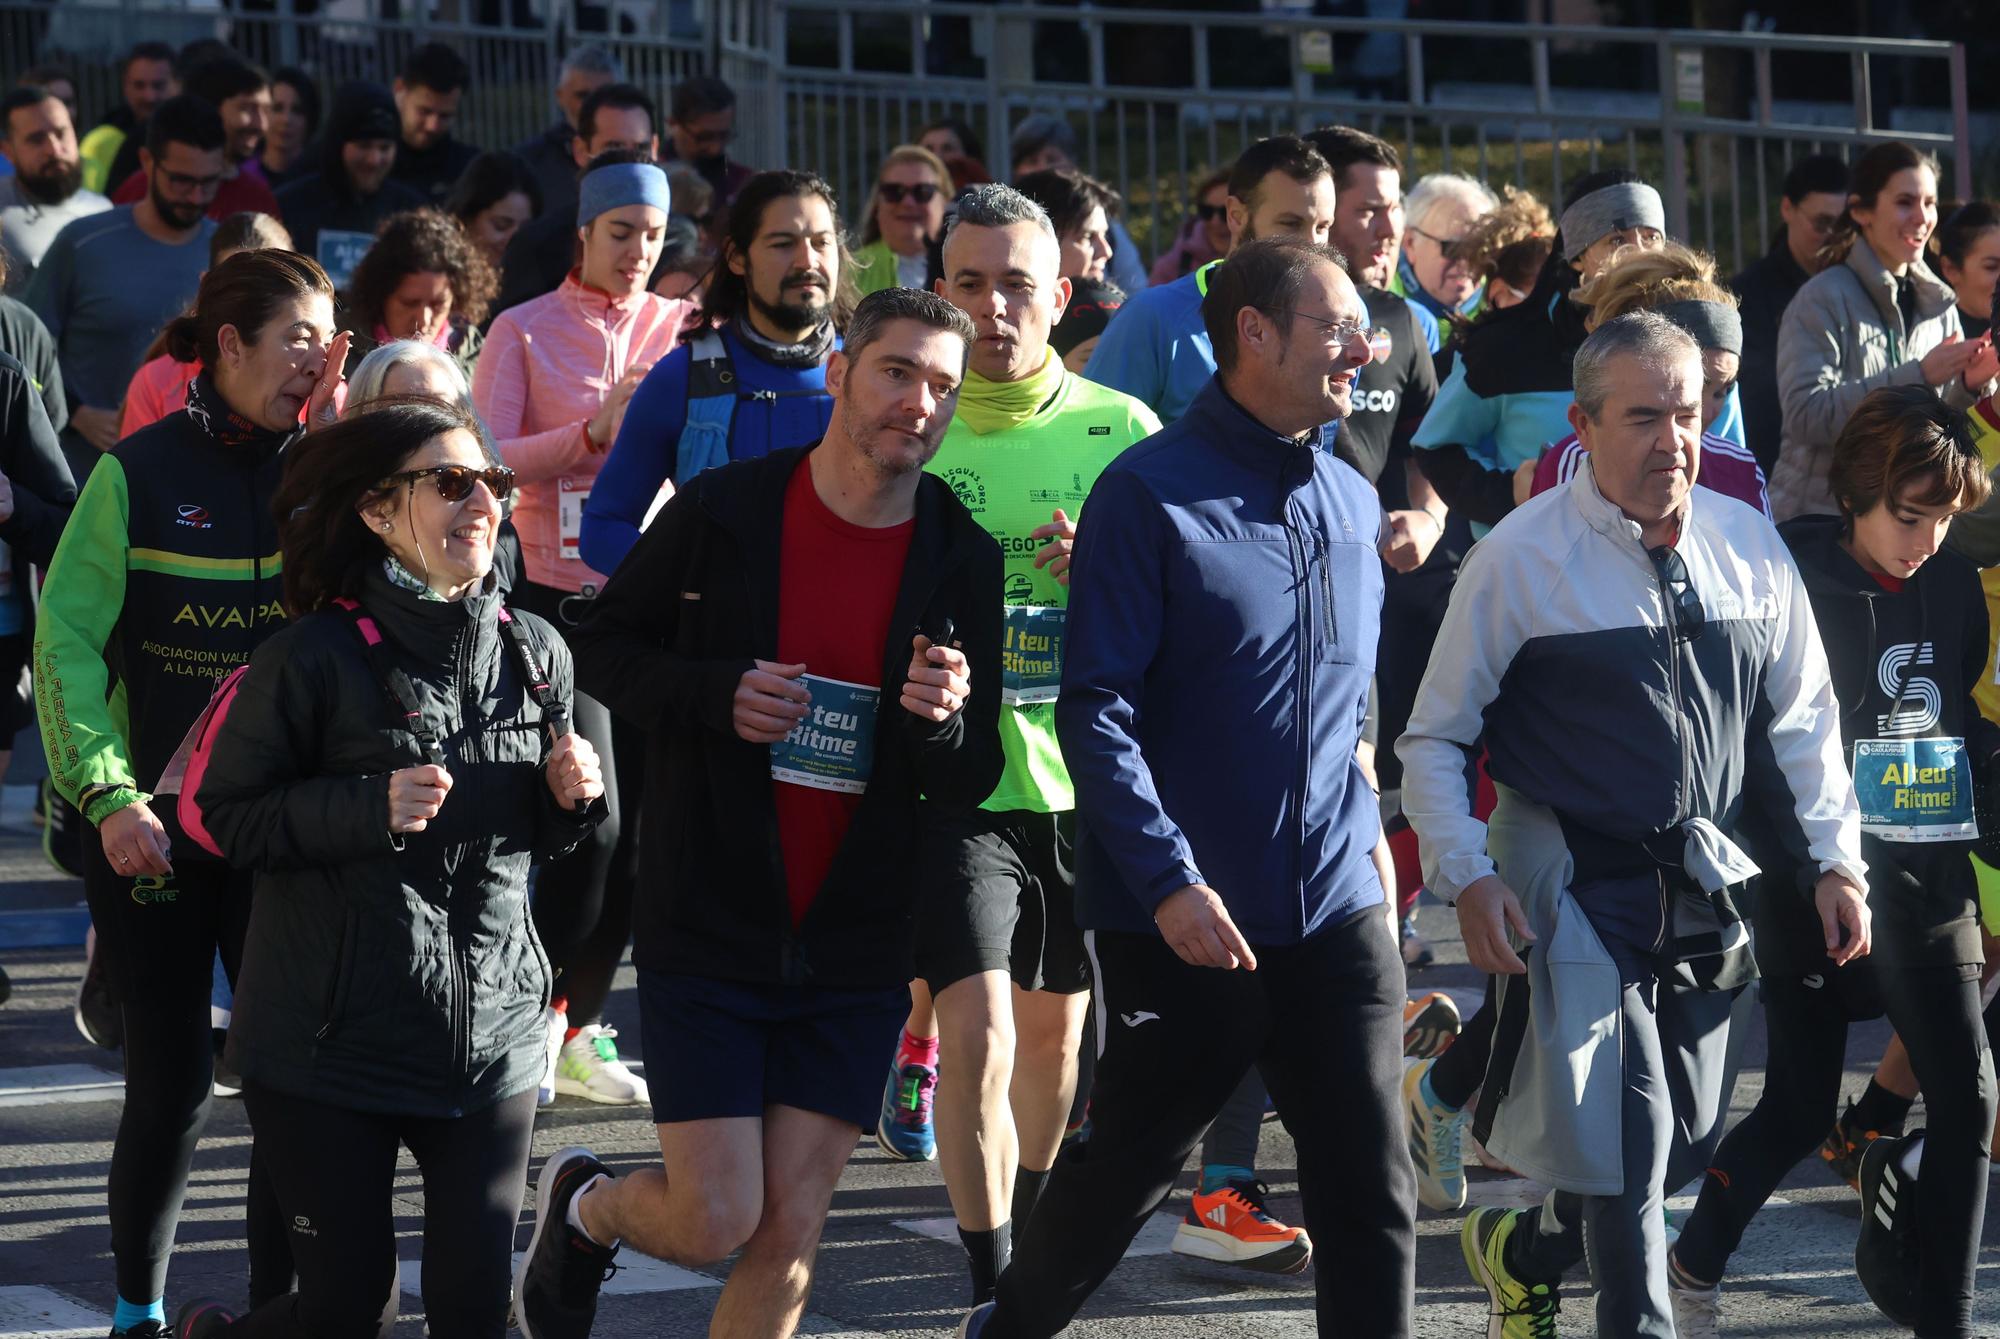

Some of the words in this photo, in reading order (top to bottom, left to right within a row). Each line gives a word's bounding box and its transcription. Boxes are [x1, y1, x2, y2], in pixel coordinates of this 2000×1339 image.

[141, 640, 218, 662] ASOCIACION
[1019, 630, 1049, 653] teu
[46, 654, 57, 675] LA
[163, 662, 173, 673] A
[177, 663, 194, 676] LA
[50, 679, 73, 742] FUERZA
[813, 704, 858, 732] teu
[1894, 788, 1951, 809] Ritme
